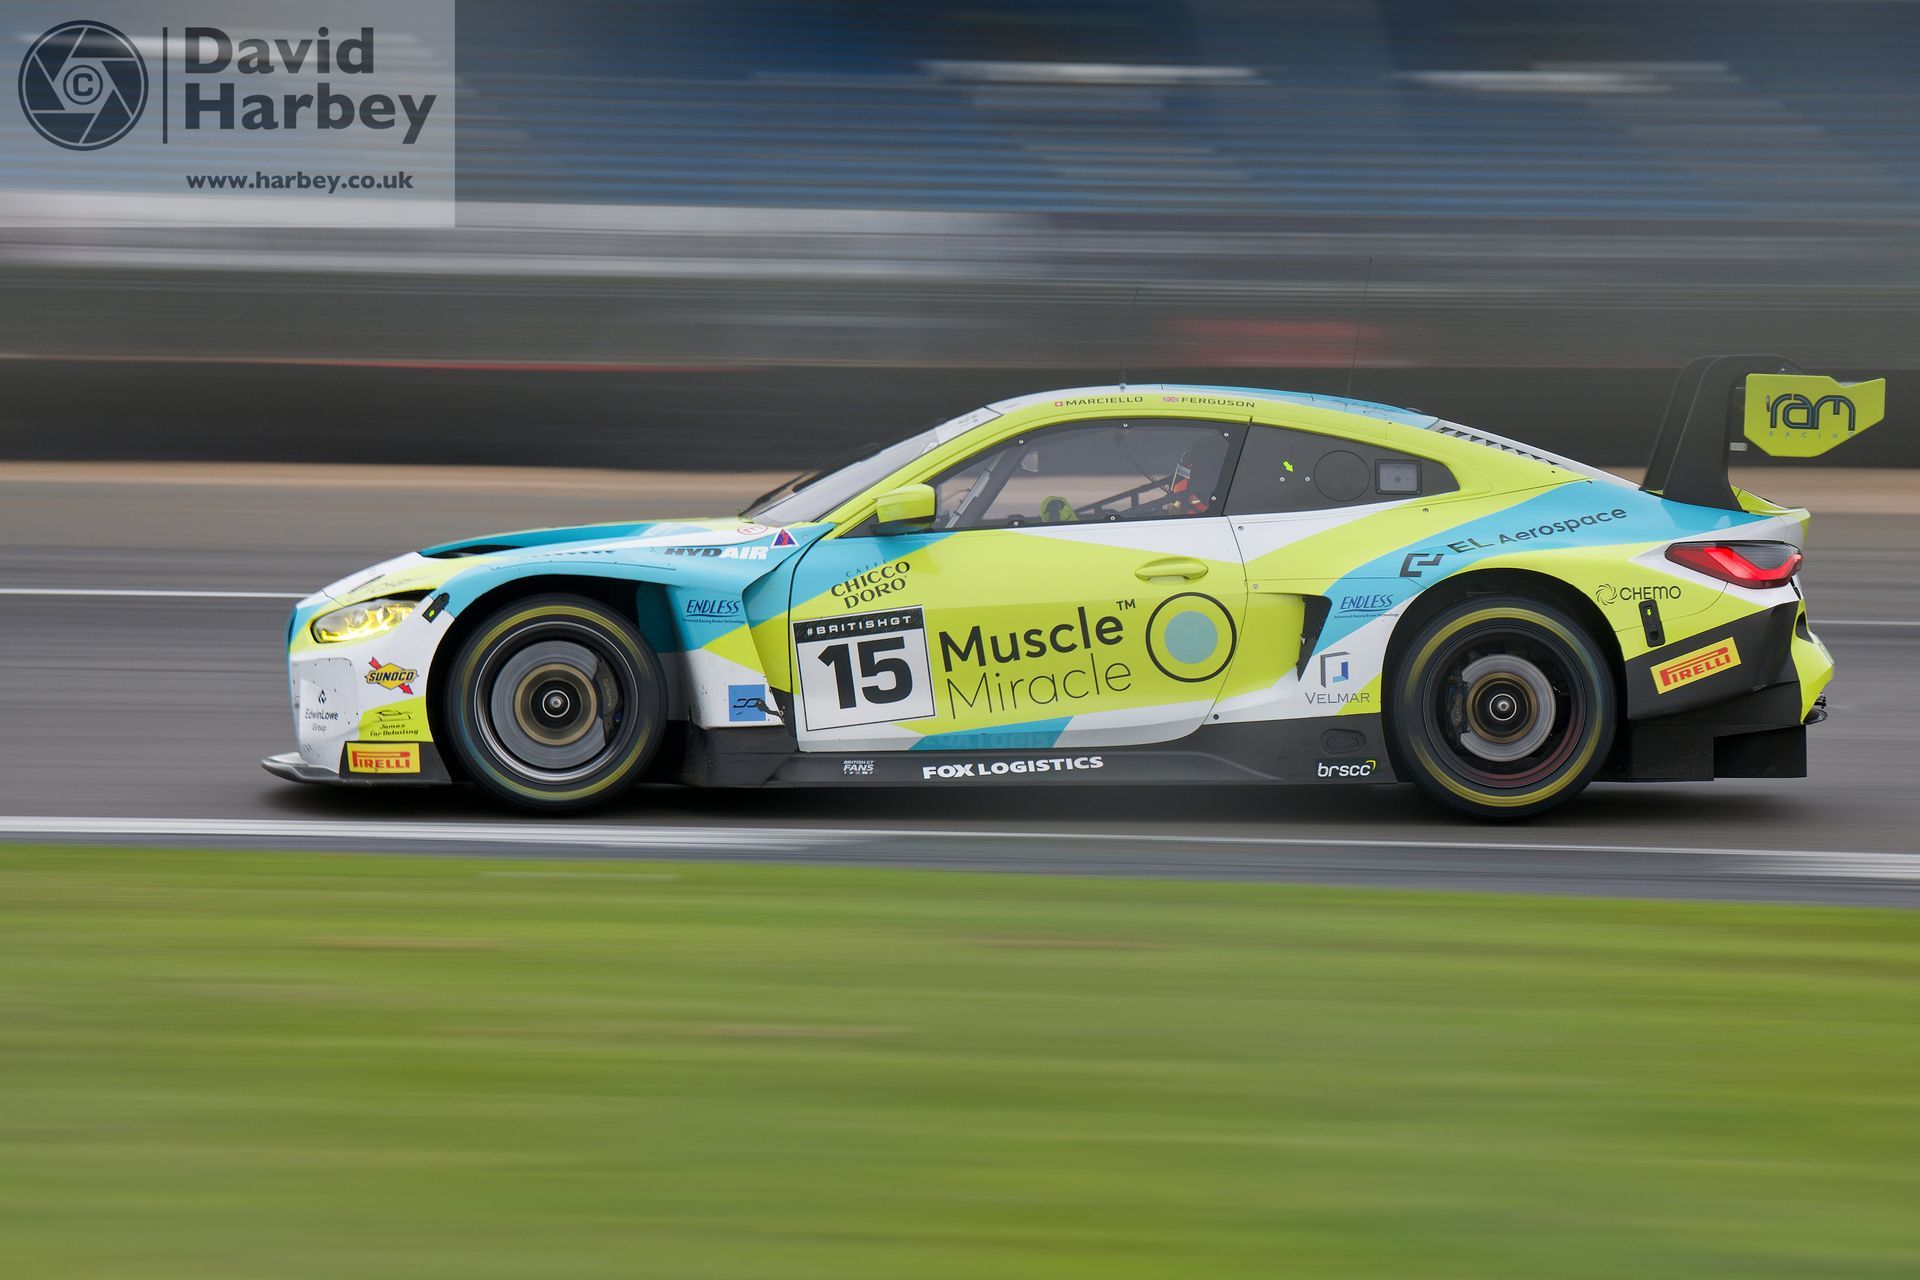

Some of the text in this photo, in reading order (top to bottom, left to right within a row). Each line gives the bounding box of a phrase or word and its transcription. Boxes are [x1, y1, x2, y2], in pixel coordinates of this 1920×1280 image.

[1066, 396, 1143, 406] MARCIELLO
[1181, 396, 1256, 408] FERGUSON
[1769, 393, 1857, 431] ram
[1446, 508, 1627, 554] EL Aerospace
[664, 546, 769, 560] HYDAIR
[831, 561, 910, 597] CHICCO
[843, 578, 906, 609] D'ORO
[1340, 594, 1395, 610] ENDLESS
[1619, 586, 1681, 601] CHEMO
[686, 599, 741, 614] ENDLESS
[806, 615, 912, 636] #BRITISHGT
[817, 636, 914, 710] 15
[1659, 647, 1732, 687] PIRELLI
[368, 671, 415, 682] SUNOCO
[946, 653, 1131, 719] Miracle
[1305, 692, 1370, 704] VELMAR
[352, 751, 411, 769] PIRELLI
[922, 756, 1105, 780] FOX LOGISTICS
[1317, 762, 1371, 777] brscc
